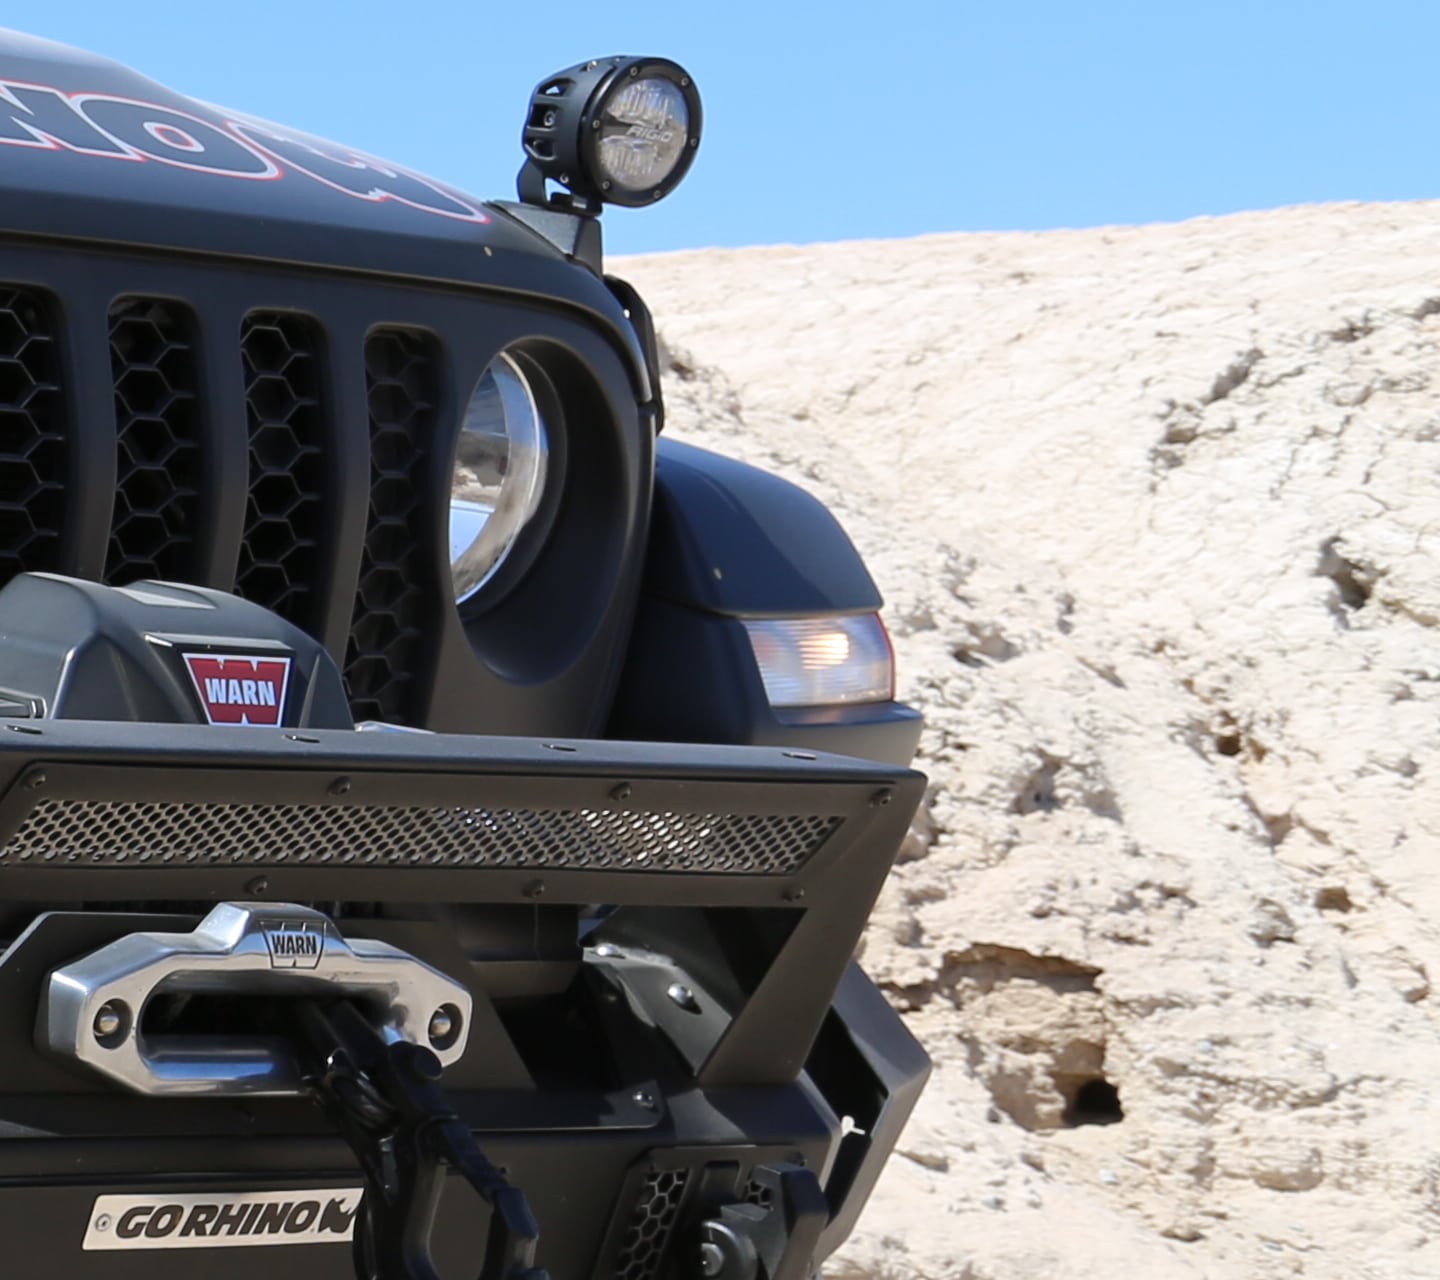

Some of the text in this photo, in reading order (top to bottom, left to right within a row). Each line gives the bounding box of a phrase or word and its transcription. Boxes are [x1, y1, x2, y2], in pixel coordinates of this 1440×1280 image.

[626, 125, 673, 142] RIGID
[205, 676, 277, 707] WARN
[269, 932, 319, 957] WARN
